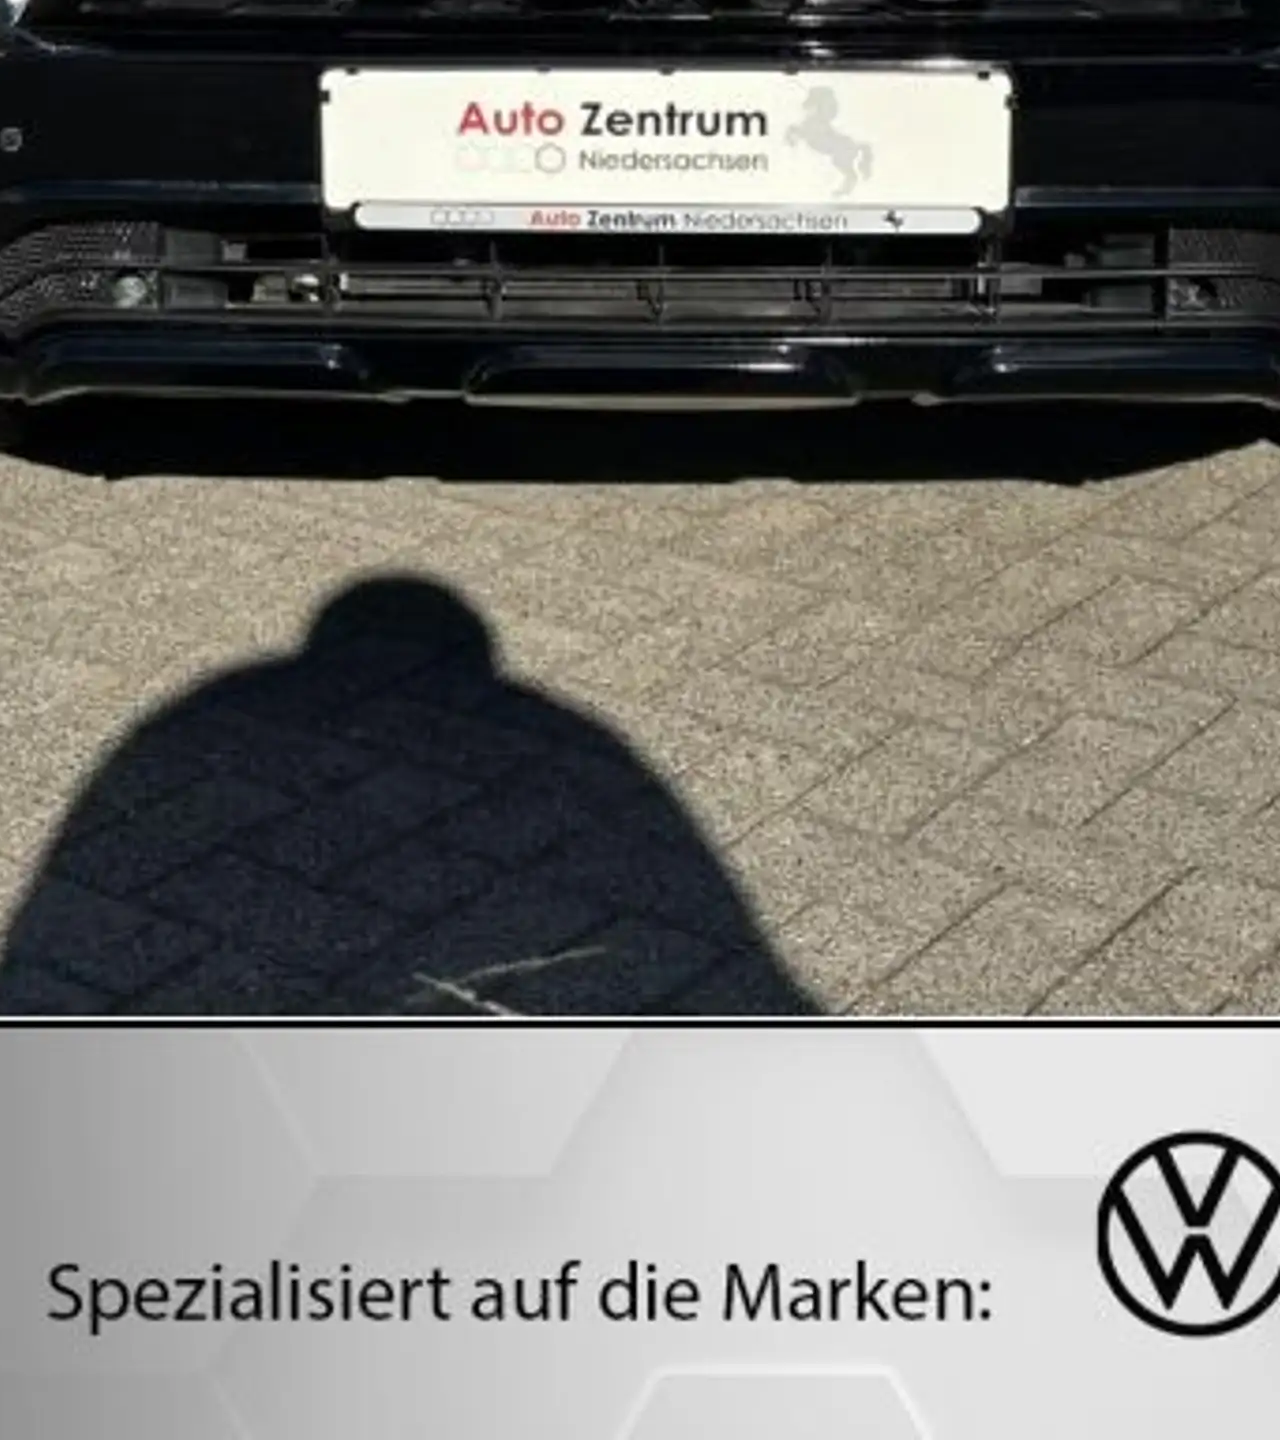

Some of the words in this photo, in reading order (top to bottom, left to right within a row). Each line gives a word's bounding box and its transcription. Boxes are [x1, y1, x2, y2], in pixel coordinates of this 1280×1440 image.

[459, 102, 565, 137] Auto
[580, 102, 767, 137] Zentrum
[579, 150, 767, 173] Niedersachsen
[531, 210, 581, 227] Auto
[587, 210, 676, 228] Zentrum
